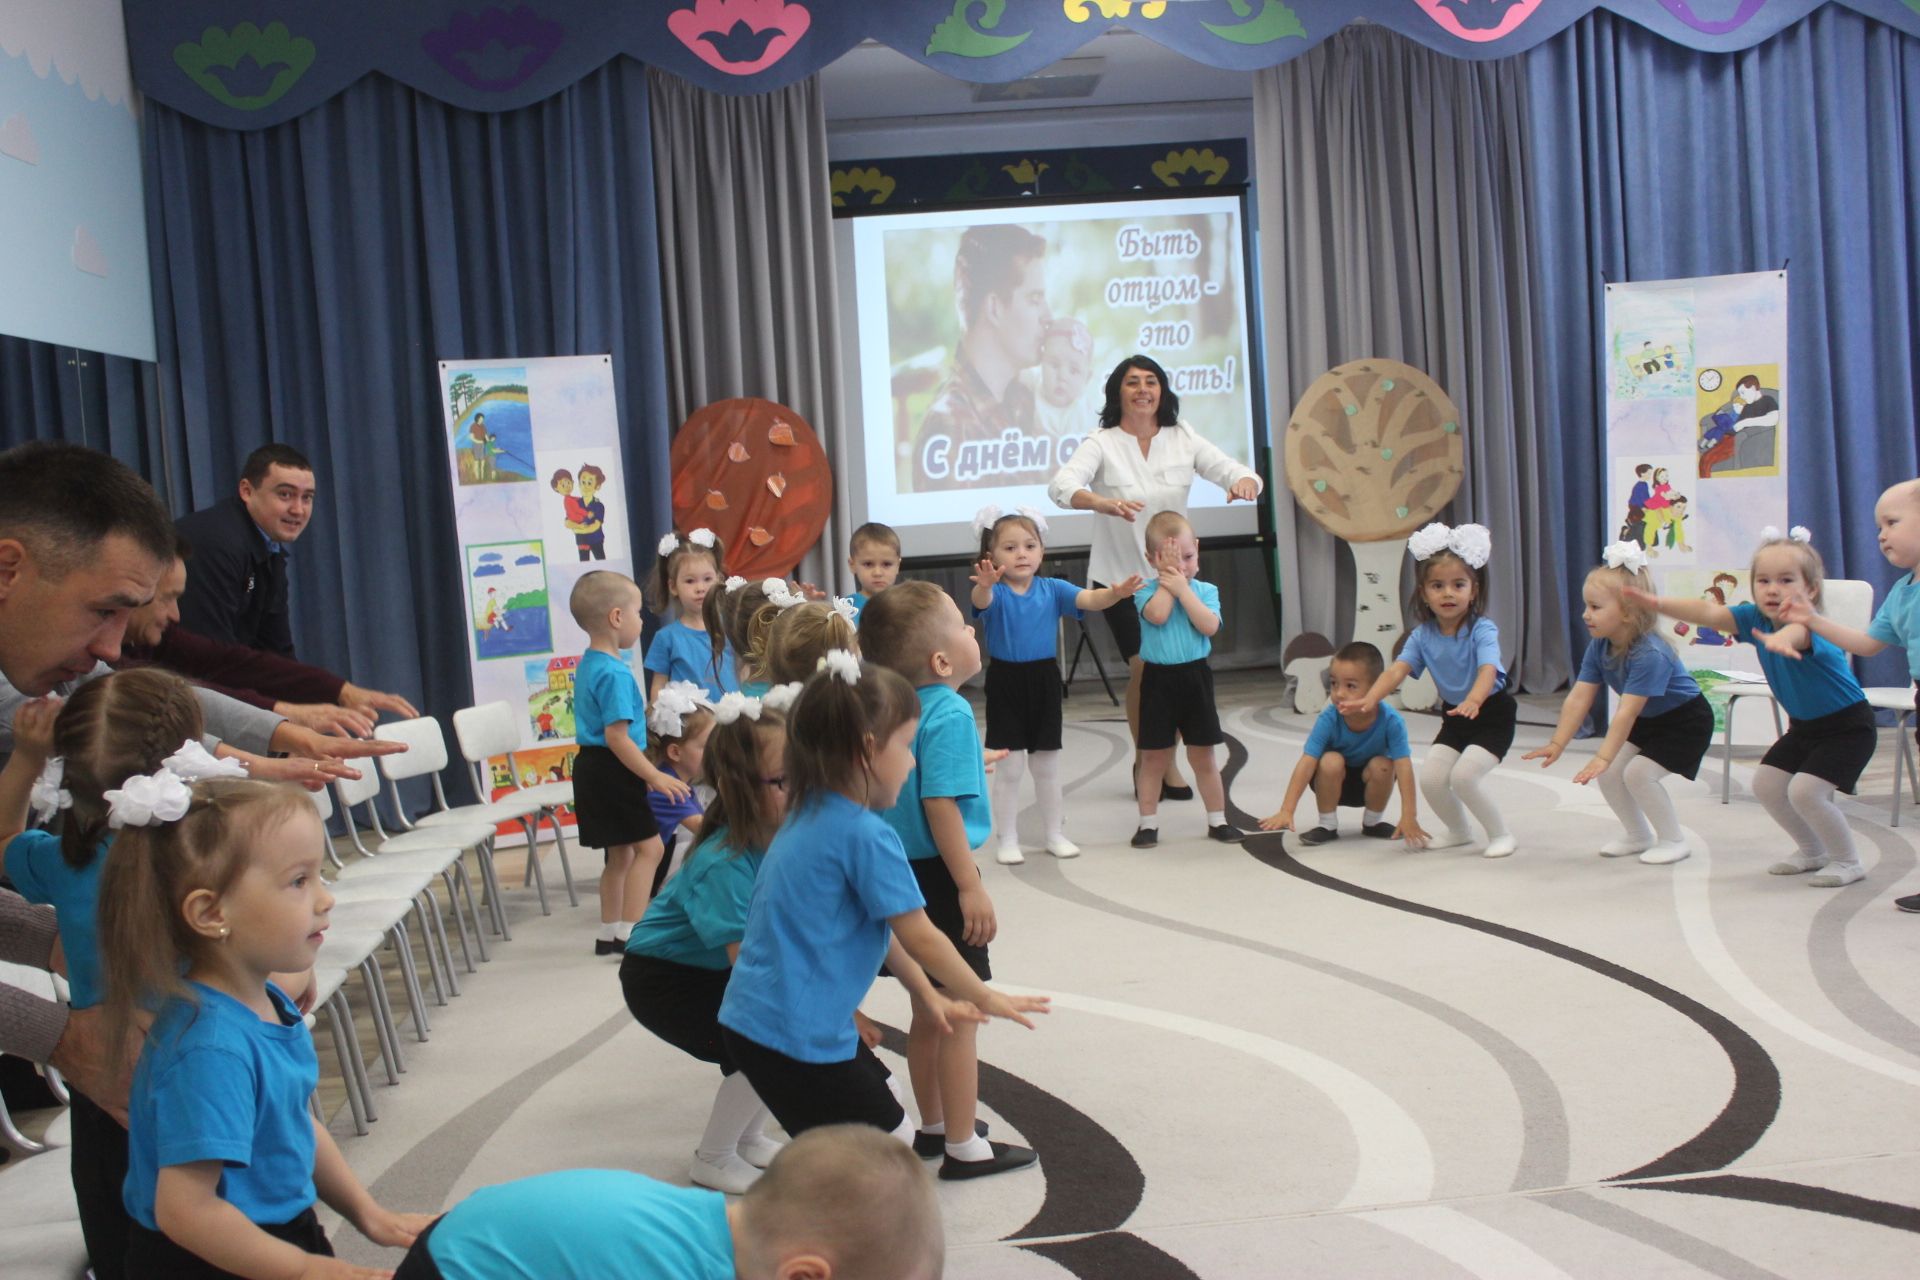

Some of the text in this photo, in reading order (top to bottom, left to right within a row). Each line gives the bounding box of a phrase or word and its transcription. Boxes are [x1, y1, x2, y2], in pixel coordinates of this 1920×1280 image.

[1119, 227, 1199, 257] Быть
[1139, 323, 1191, 348] это
[926, 438, 949, 475] С
[957, 432, 1049, 477] днём
